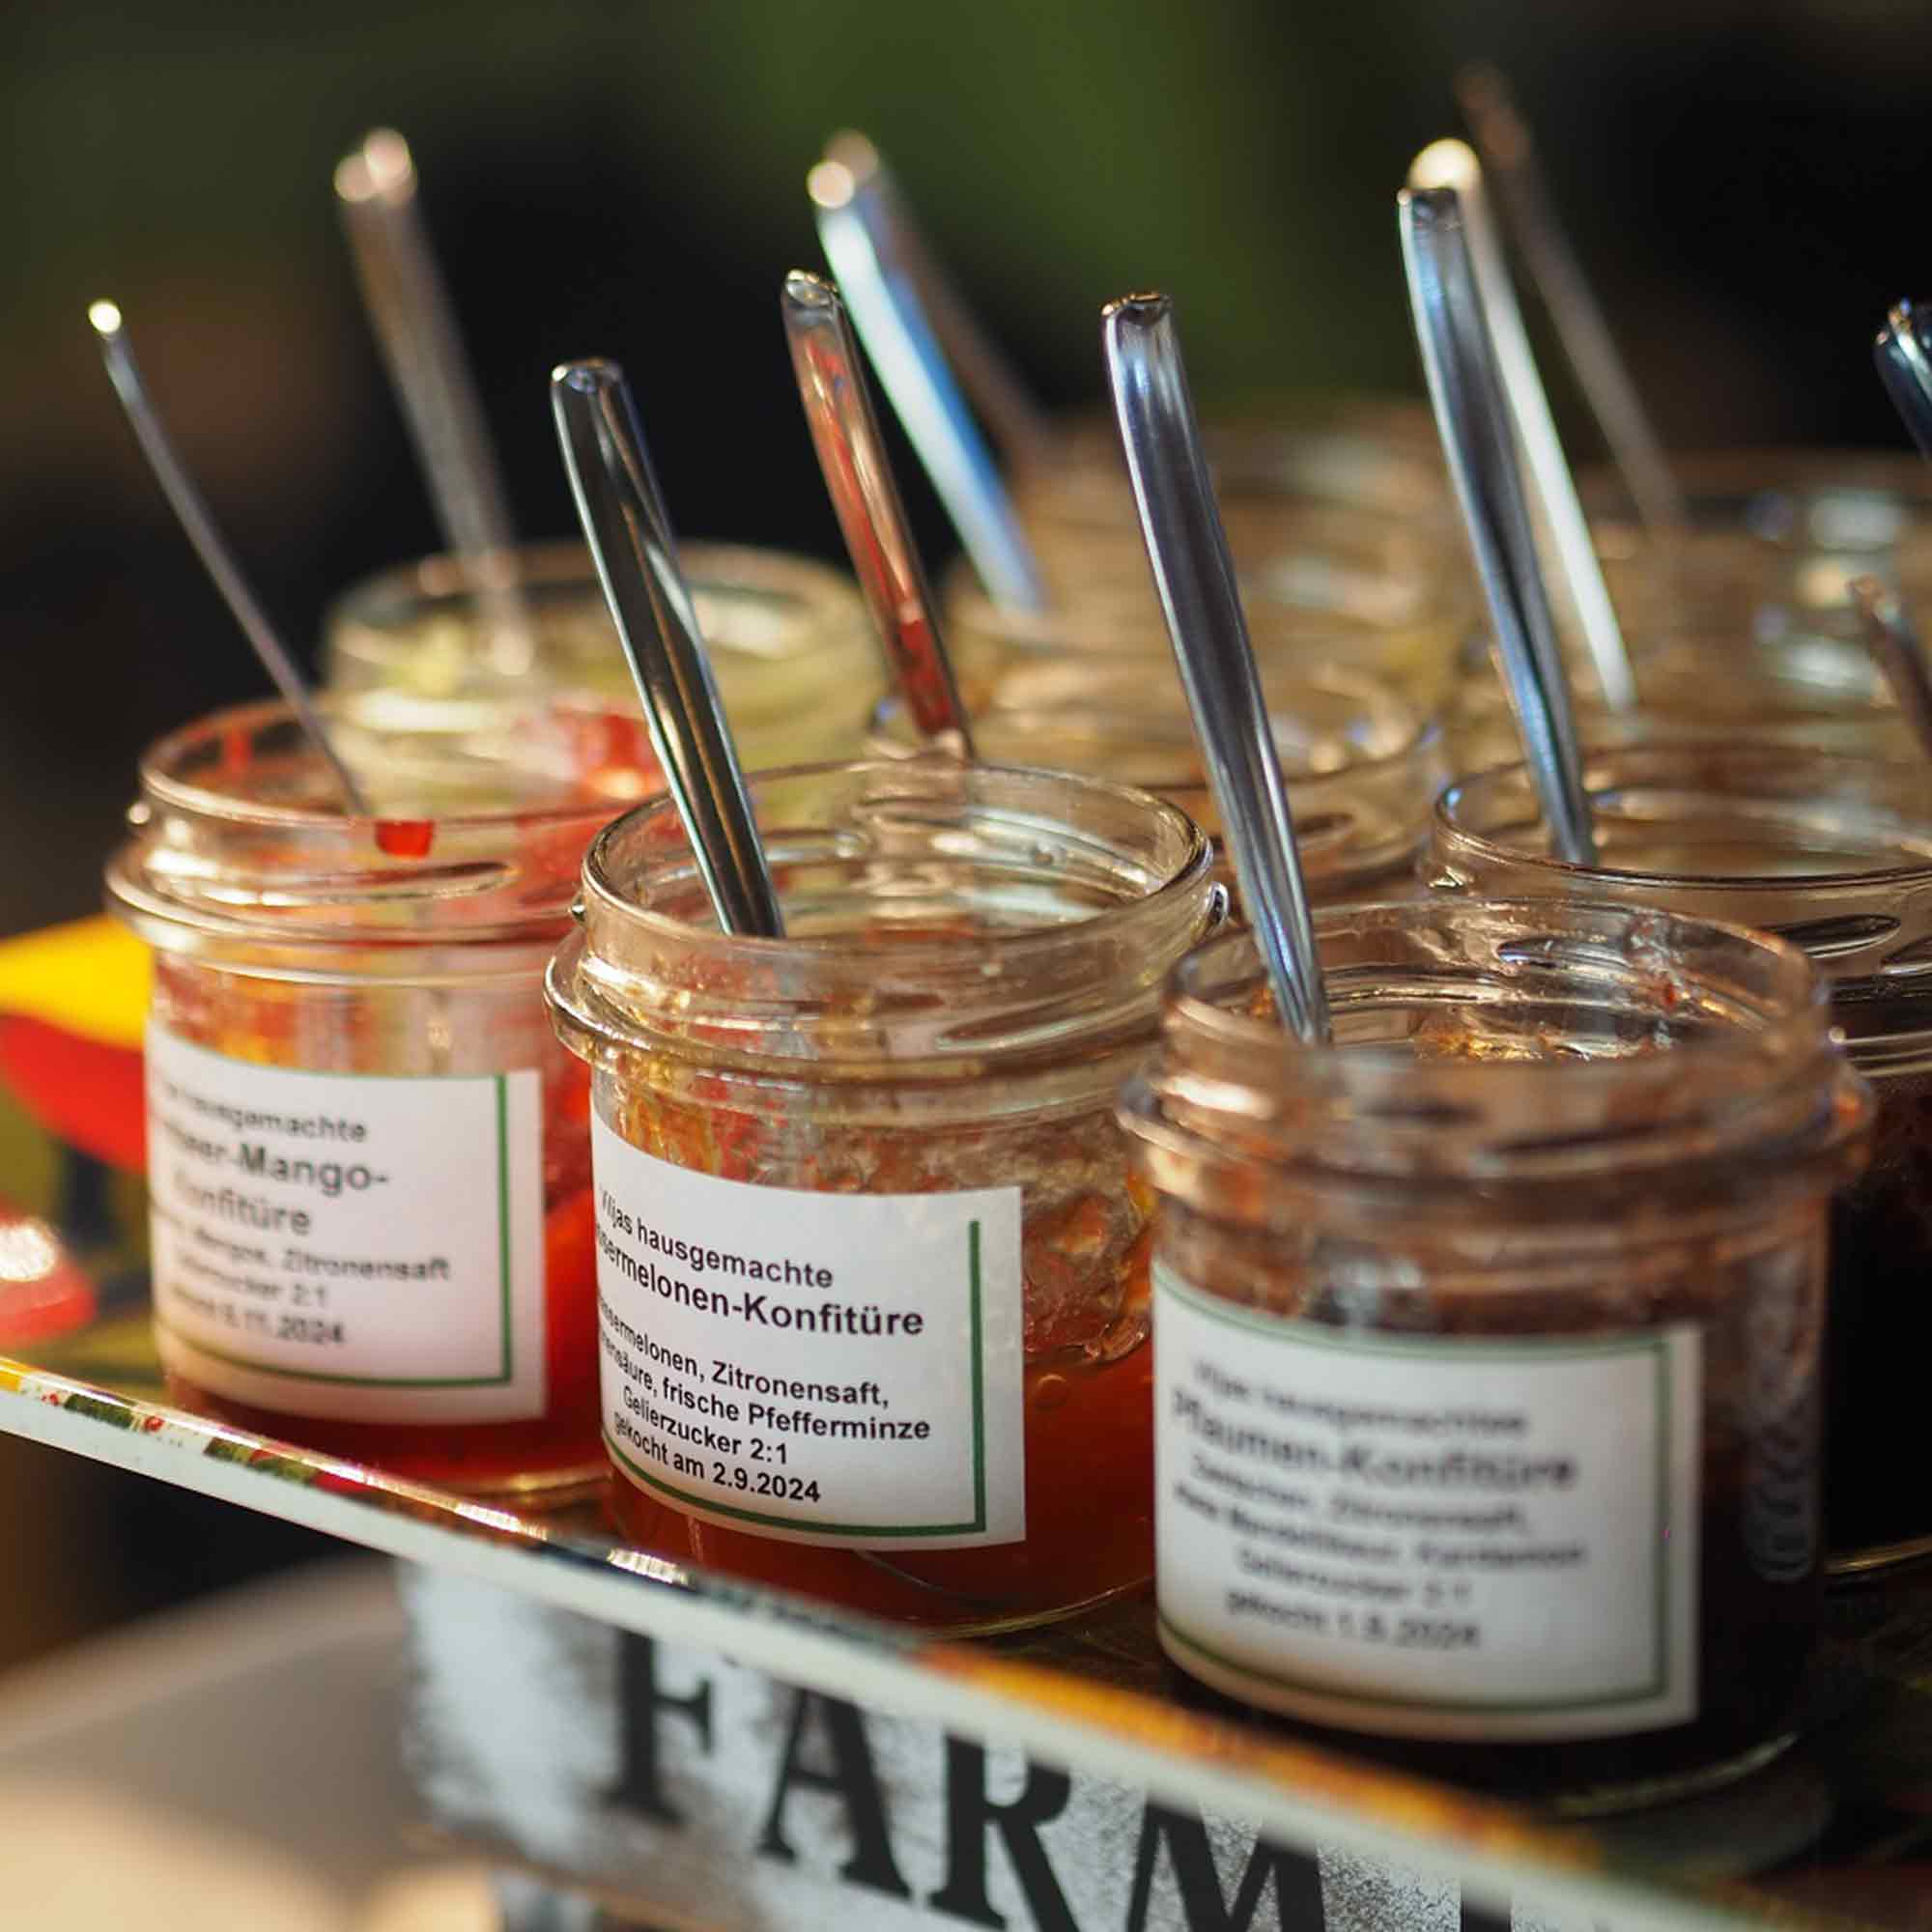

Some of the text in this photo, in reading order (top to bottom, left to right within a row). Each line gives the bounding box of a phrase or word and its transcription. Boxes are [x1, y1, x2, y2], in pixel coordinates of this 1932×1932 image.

[286, 1248, 450, 1281] Zitronensaft
[637, 1217, 834, 1289] hausgemachte
[662, 1377, 740, 1422] frische
[749, 1404, 931, 1441] Pfefferminze
[711, 1359, 890, 1409] Zitronensaft,
[613, 1411, 821, 1504] gekocht am 2.9.2024
[623, 1384, 788, 1465] Gelierzucker 2:1
[609, 1630, 1326, 1932] FARM
